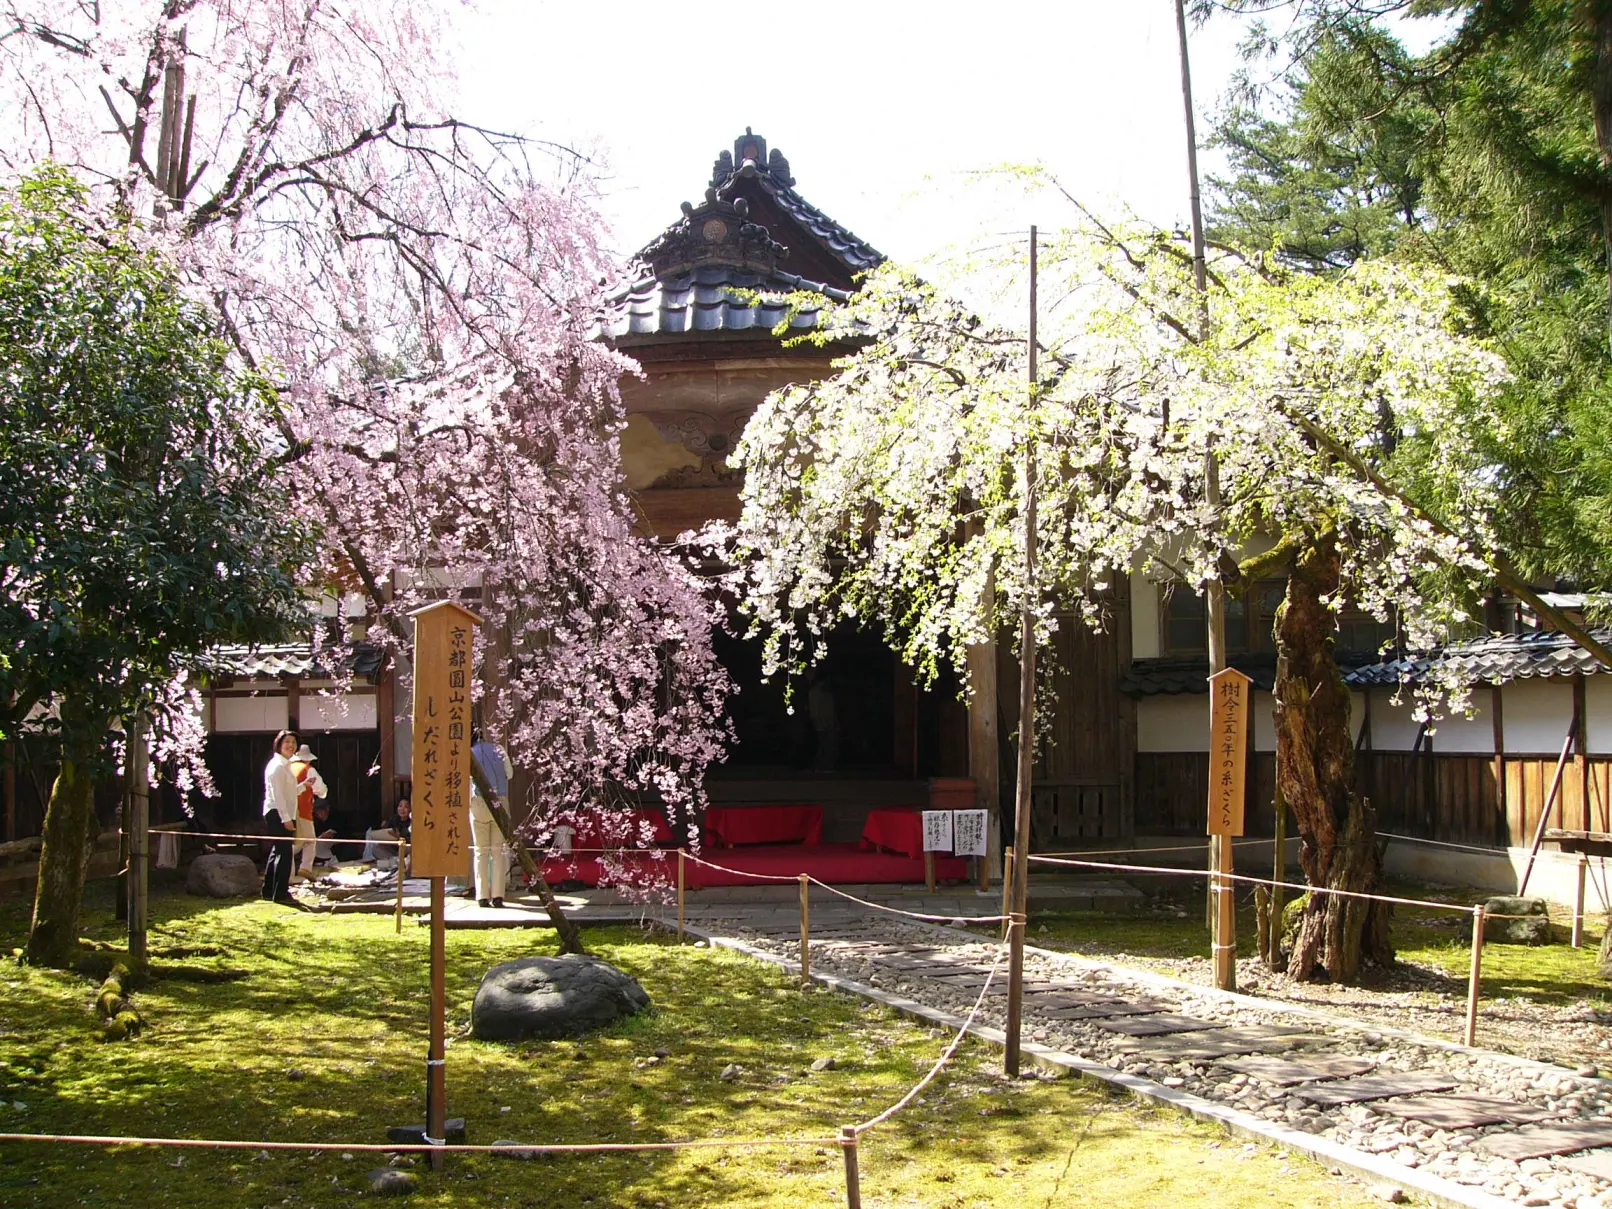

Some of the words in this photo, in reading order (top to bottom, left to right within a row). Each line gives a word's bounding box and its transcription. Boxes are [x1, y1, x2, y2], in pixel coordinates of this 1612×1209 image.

[423, 696, 439, 830] しだれざくら
